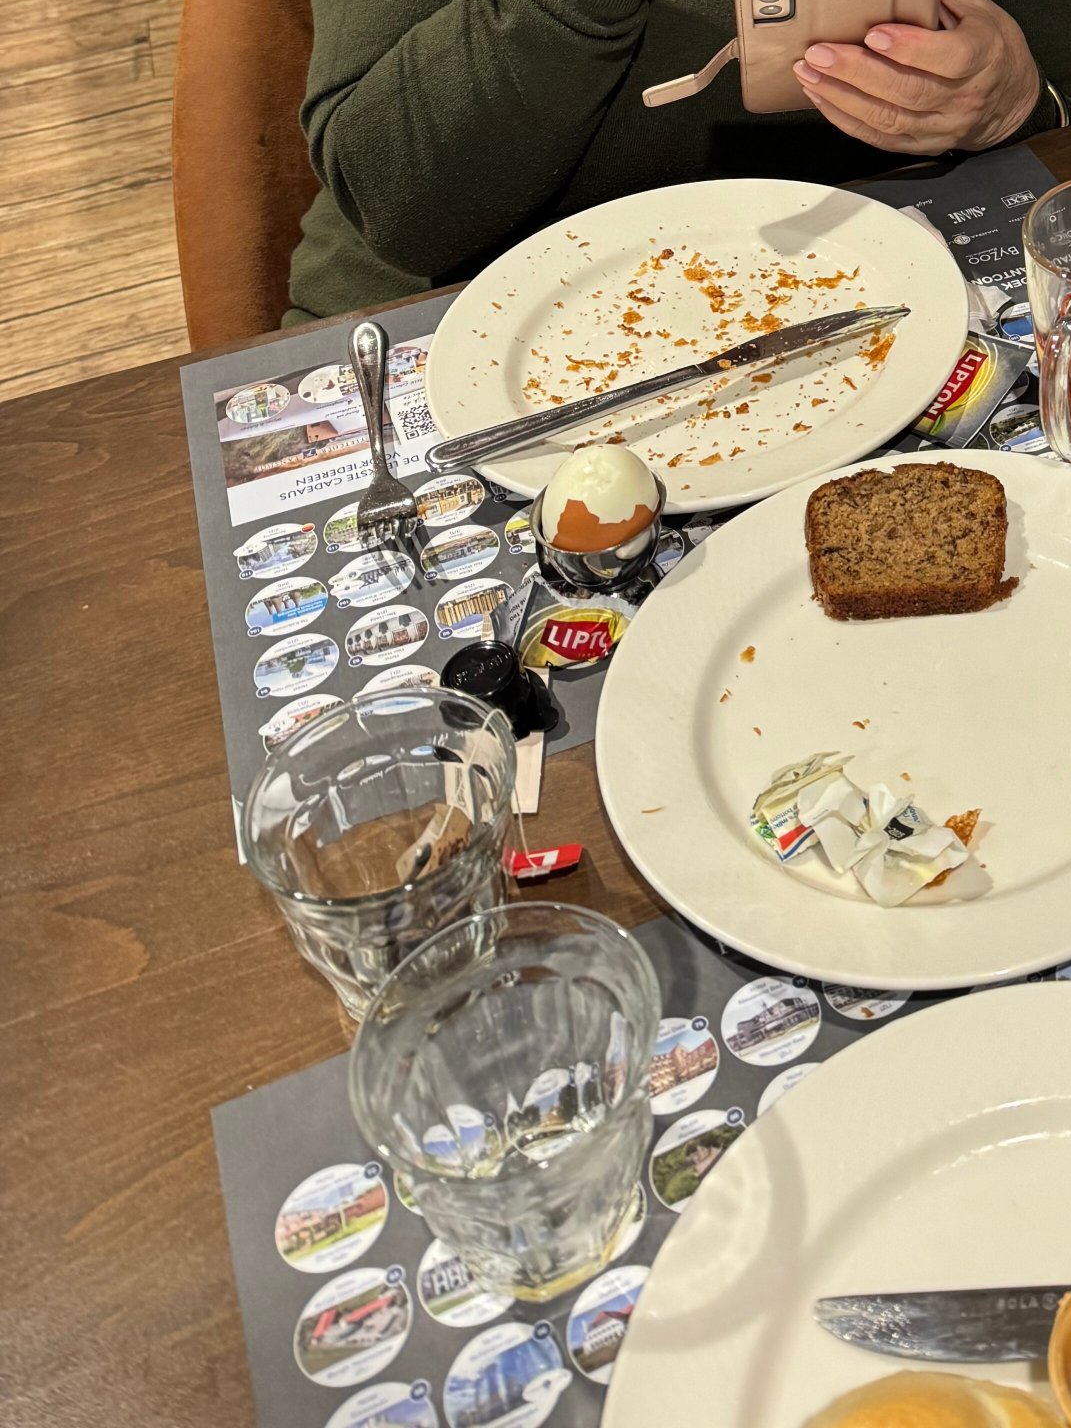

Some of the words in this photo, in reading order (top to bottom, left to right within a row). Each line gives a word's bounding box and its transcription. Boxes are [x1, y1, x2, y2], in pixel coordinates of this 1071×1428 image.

[928, 353, 983, 416] LIPTON
[348, 460, 399, 482] LEKSTE
[404, 454, 420, 465] DE
[296, 464, 357, 487] IEDEREEN
[279, 477, 343, 501] CADEAUS
[547, 625, 608, 651] LIPTO
